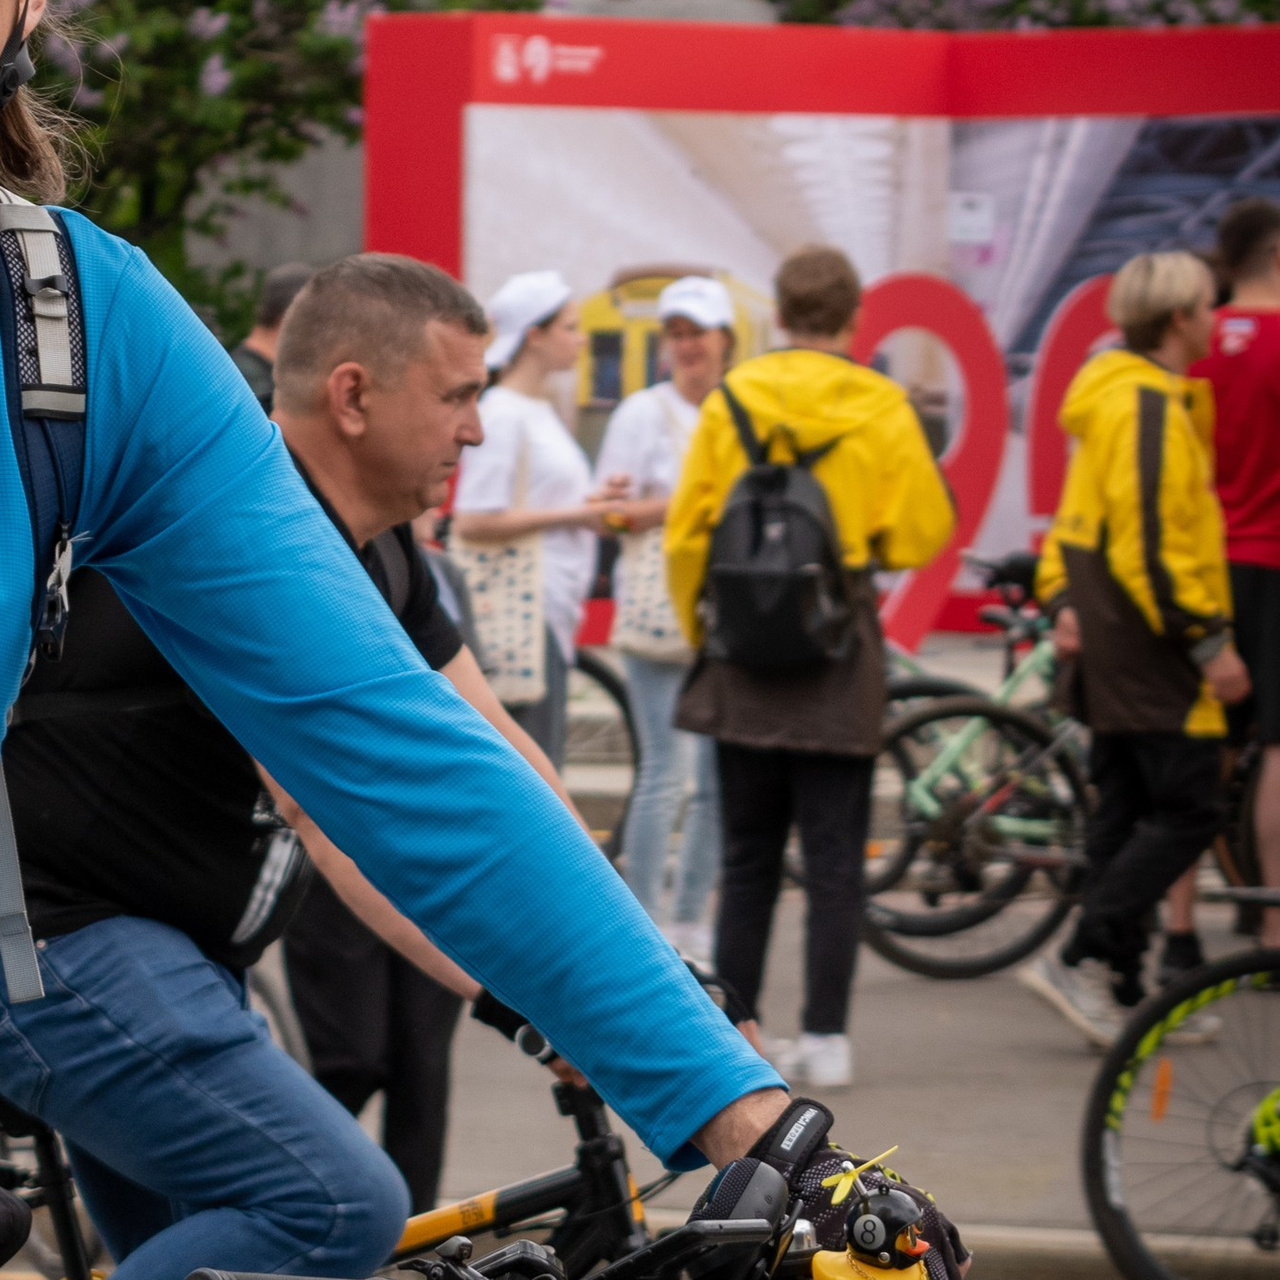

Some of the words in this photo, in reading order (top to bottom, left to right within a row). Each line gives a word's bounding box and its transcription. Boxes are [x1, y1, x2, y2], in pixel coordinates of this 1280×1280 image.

[796, 1107, 818, 1126] VINCA
[783, 1124, 803, 1149] SPORT
[860, 1219, 877, 1244] 8
